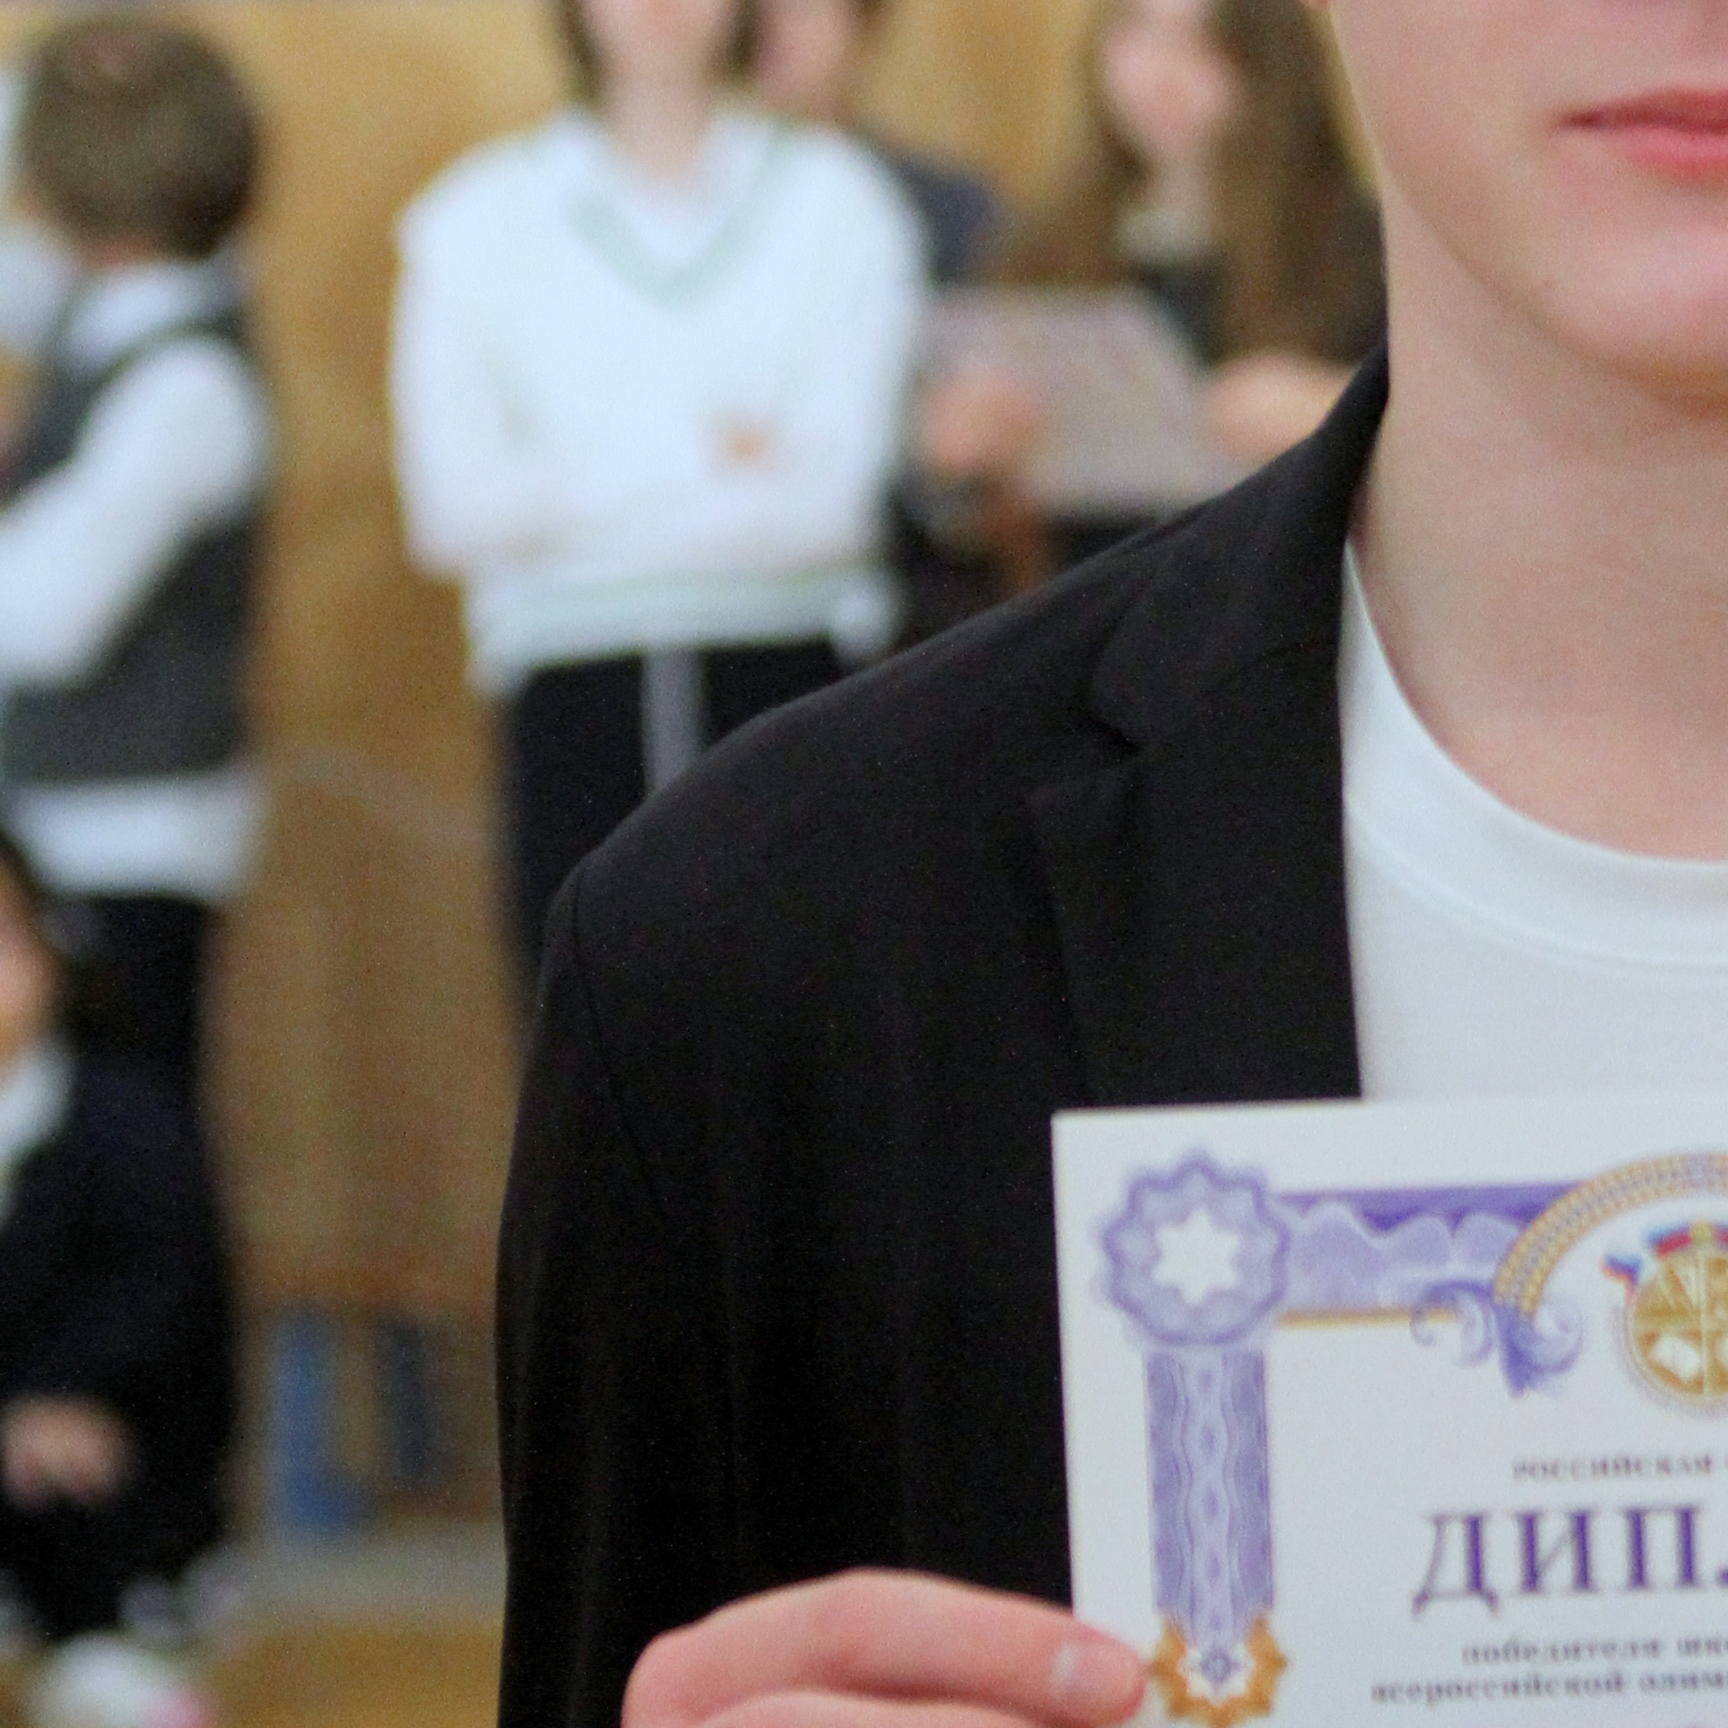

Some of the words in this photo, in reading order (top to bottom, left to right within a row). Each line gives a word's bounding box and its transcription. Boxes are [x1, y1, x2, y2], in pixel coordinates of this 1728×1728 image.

[1512, 1450, 1713, 1483] РОССИЙСКАЯ
[1461, 1634, 1662, 1668] победителя
[1372, 1666, 1626, 1708] всероссийской
